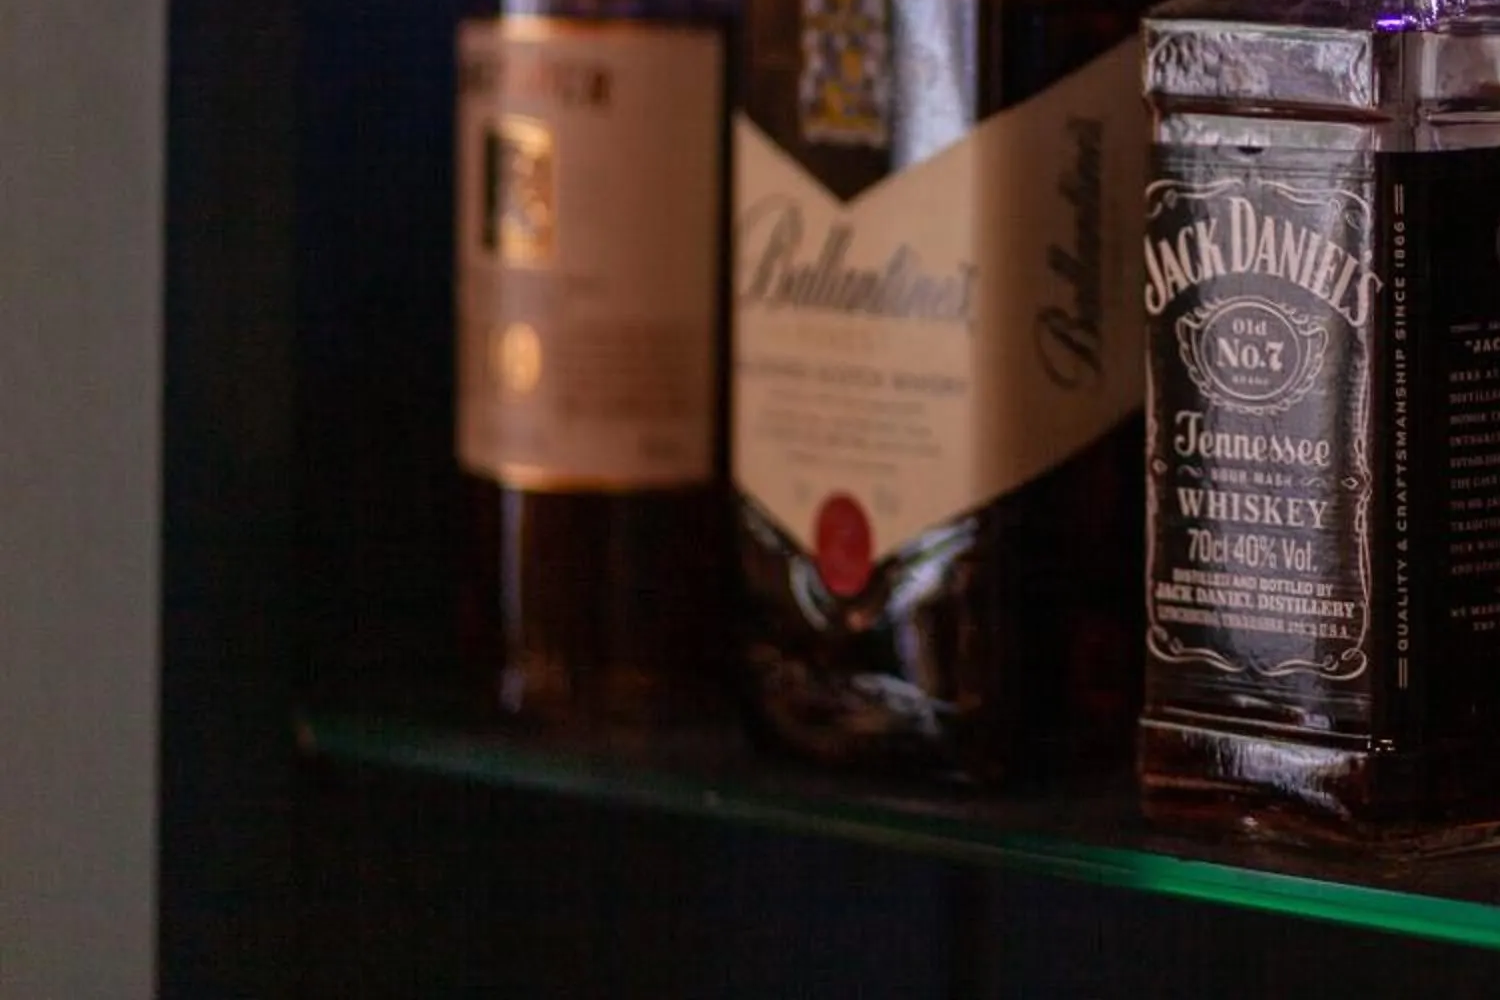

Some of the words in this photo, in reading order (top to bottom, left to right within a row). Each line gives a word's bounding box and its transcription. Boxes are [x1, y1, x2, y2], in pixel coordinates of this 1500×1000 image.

[1144, 216, 1228, 316] JACK
[1231, 317, 1268, 336] Old
[1394, 276, 1406, 341] SINCE
[1216, 337, 1284, 371] No.7
[1174, 410, 1331, 467] Tennessee
[1394, 348, 1408, 533] CRAFTSMANSHIP
[1177, 486, 1329, 529] WHISKEY
[1186, 527, 1228, 563] 70cl
[1233, 533, 1277, 569] 40%
[1282, 538, 1318, 572] Vol.
[1396, 538, 1408, 551] &
[1258, 595, 1356, 619] DISTILLERY
[1316, 582, 1334, 598] BY
[1396, 559, 1408, 651] QUALITY
